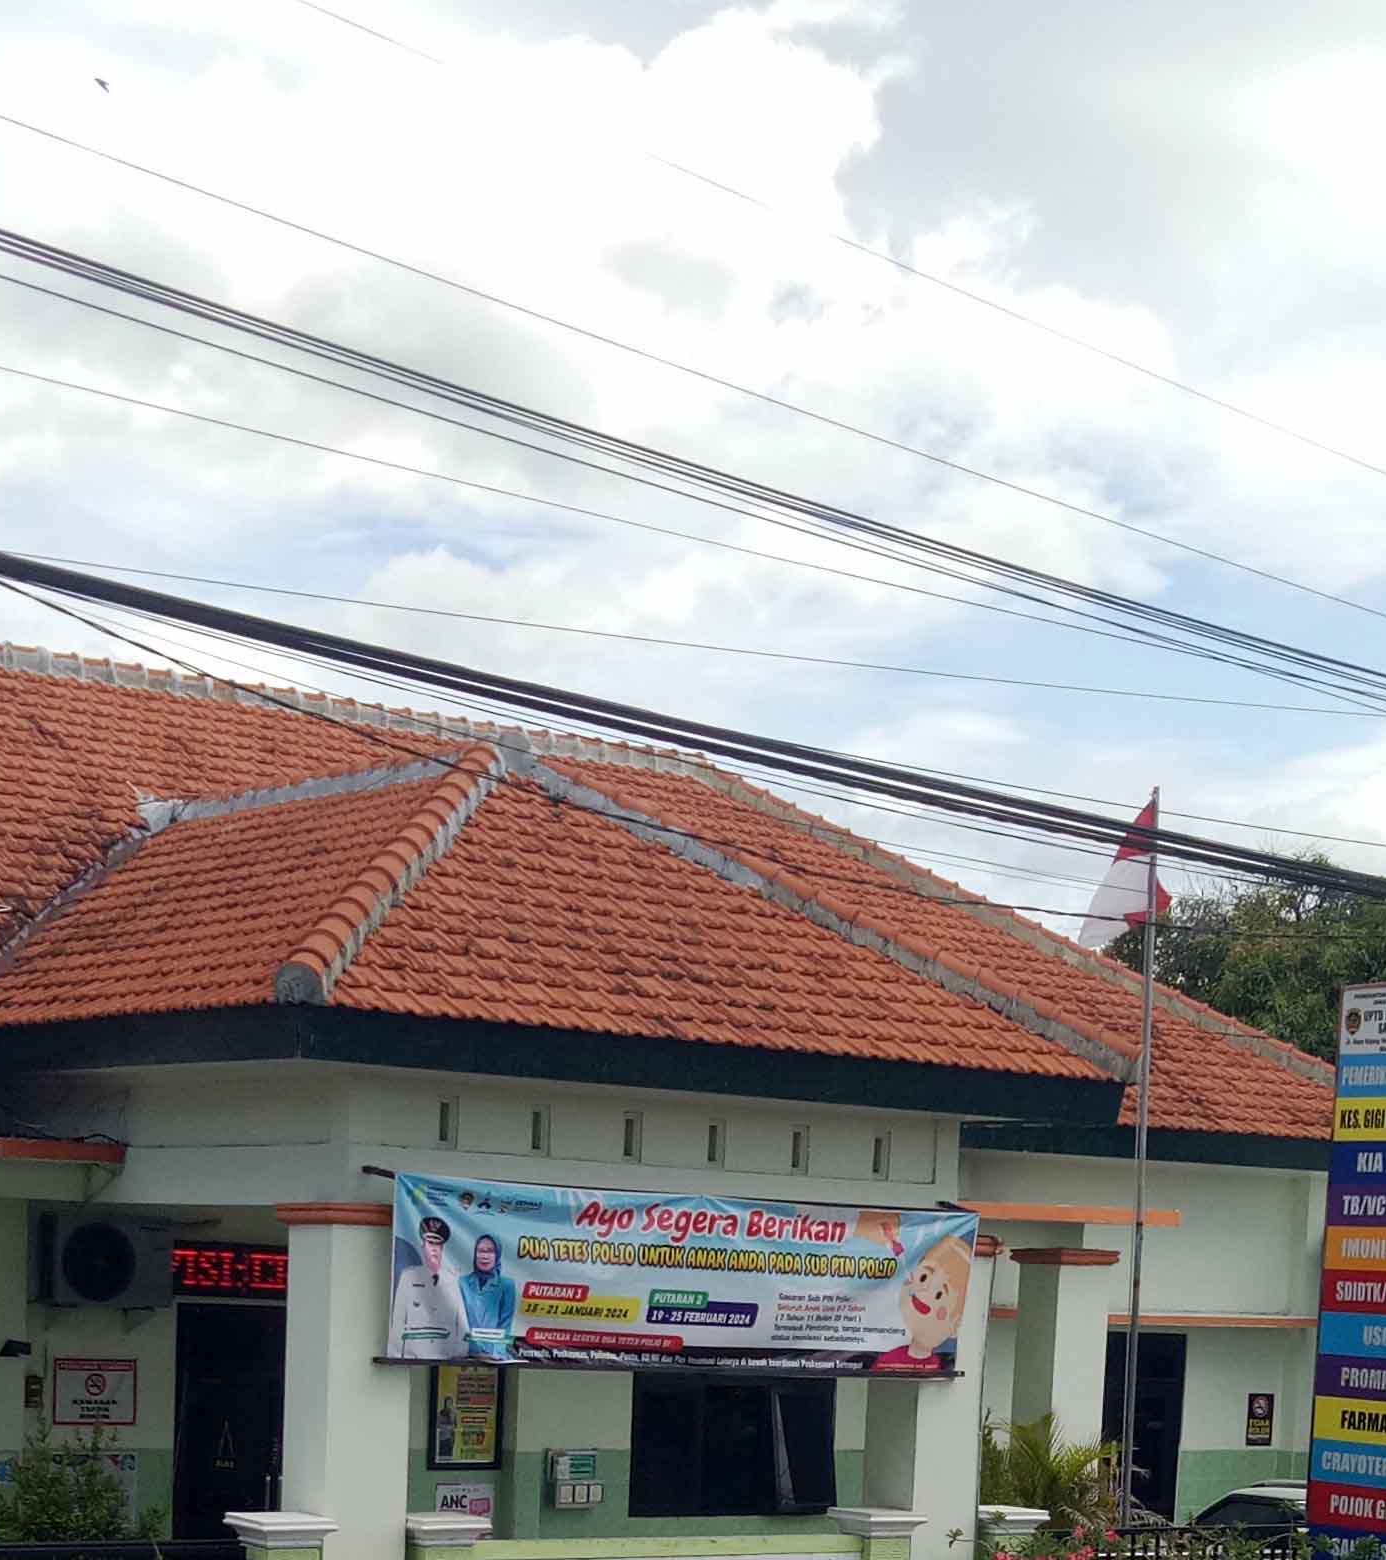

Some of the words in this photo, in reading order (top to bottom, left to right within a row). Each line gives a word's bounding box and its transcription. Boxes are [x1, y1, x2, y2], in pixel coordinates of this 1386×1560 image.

[1340, 1109, 1361, 1129] KES.
[1363, 1109, 1386, 1129] GIGI
[1357, 1152, 1383, 1173] KIA
[576, 1200, 635, 1239] Ayo
[641, 1202, 739, 1244] Segera
[745, 1209, 847, 1243] Berikan
[519, 1236, 550, 1260] DUA
[551, 1238, 590, 1263] TETES
[591, 1240, 635, 1266] POLIO
[638, 1243, 687, 1268] UNTUK
[687, 1246, 726, 1271] ANAK
[728, 1249, 767, 1273] ANDA
[768, 1251, 803, 1276] PADA
[804, 1253, 829, 1277] SUB
[830, 1255, 856, 1278] PIN
[858, 1257, 898, 1280] POLIO
[528, 1284, 575, 1298] PUTARAN
[576, 1287, 583, 1299] 1
[653, 1293, 695, 1305] PUTARAN
[696, 1295, 703, 1305] 2
[547, 1304, 558, 1315] 21
[561, 1305, 603, 1318] JANUARI
[604, 1307, 630, 1319] 2024
[652, 1310, 664, 1321] 19
[671, 1311, 682, 1321] 25
[683, 1311, 727, 1324] FEBRUARI
[727, 1314, 751, 1325] 2024
[440, 1494, 468, 1509] ANC
[1330, 1494, 1373, 1518] POJOK
